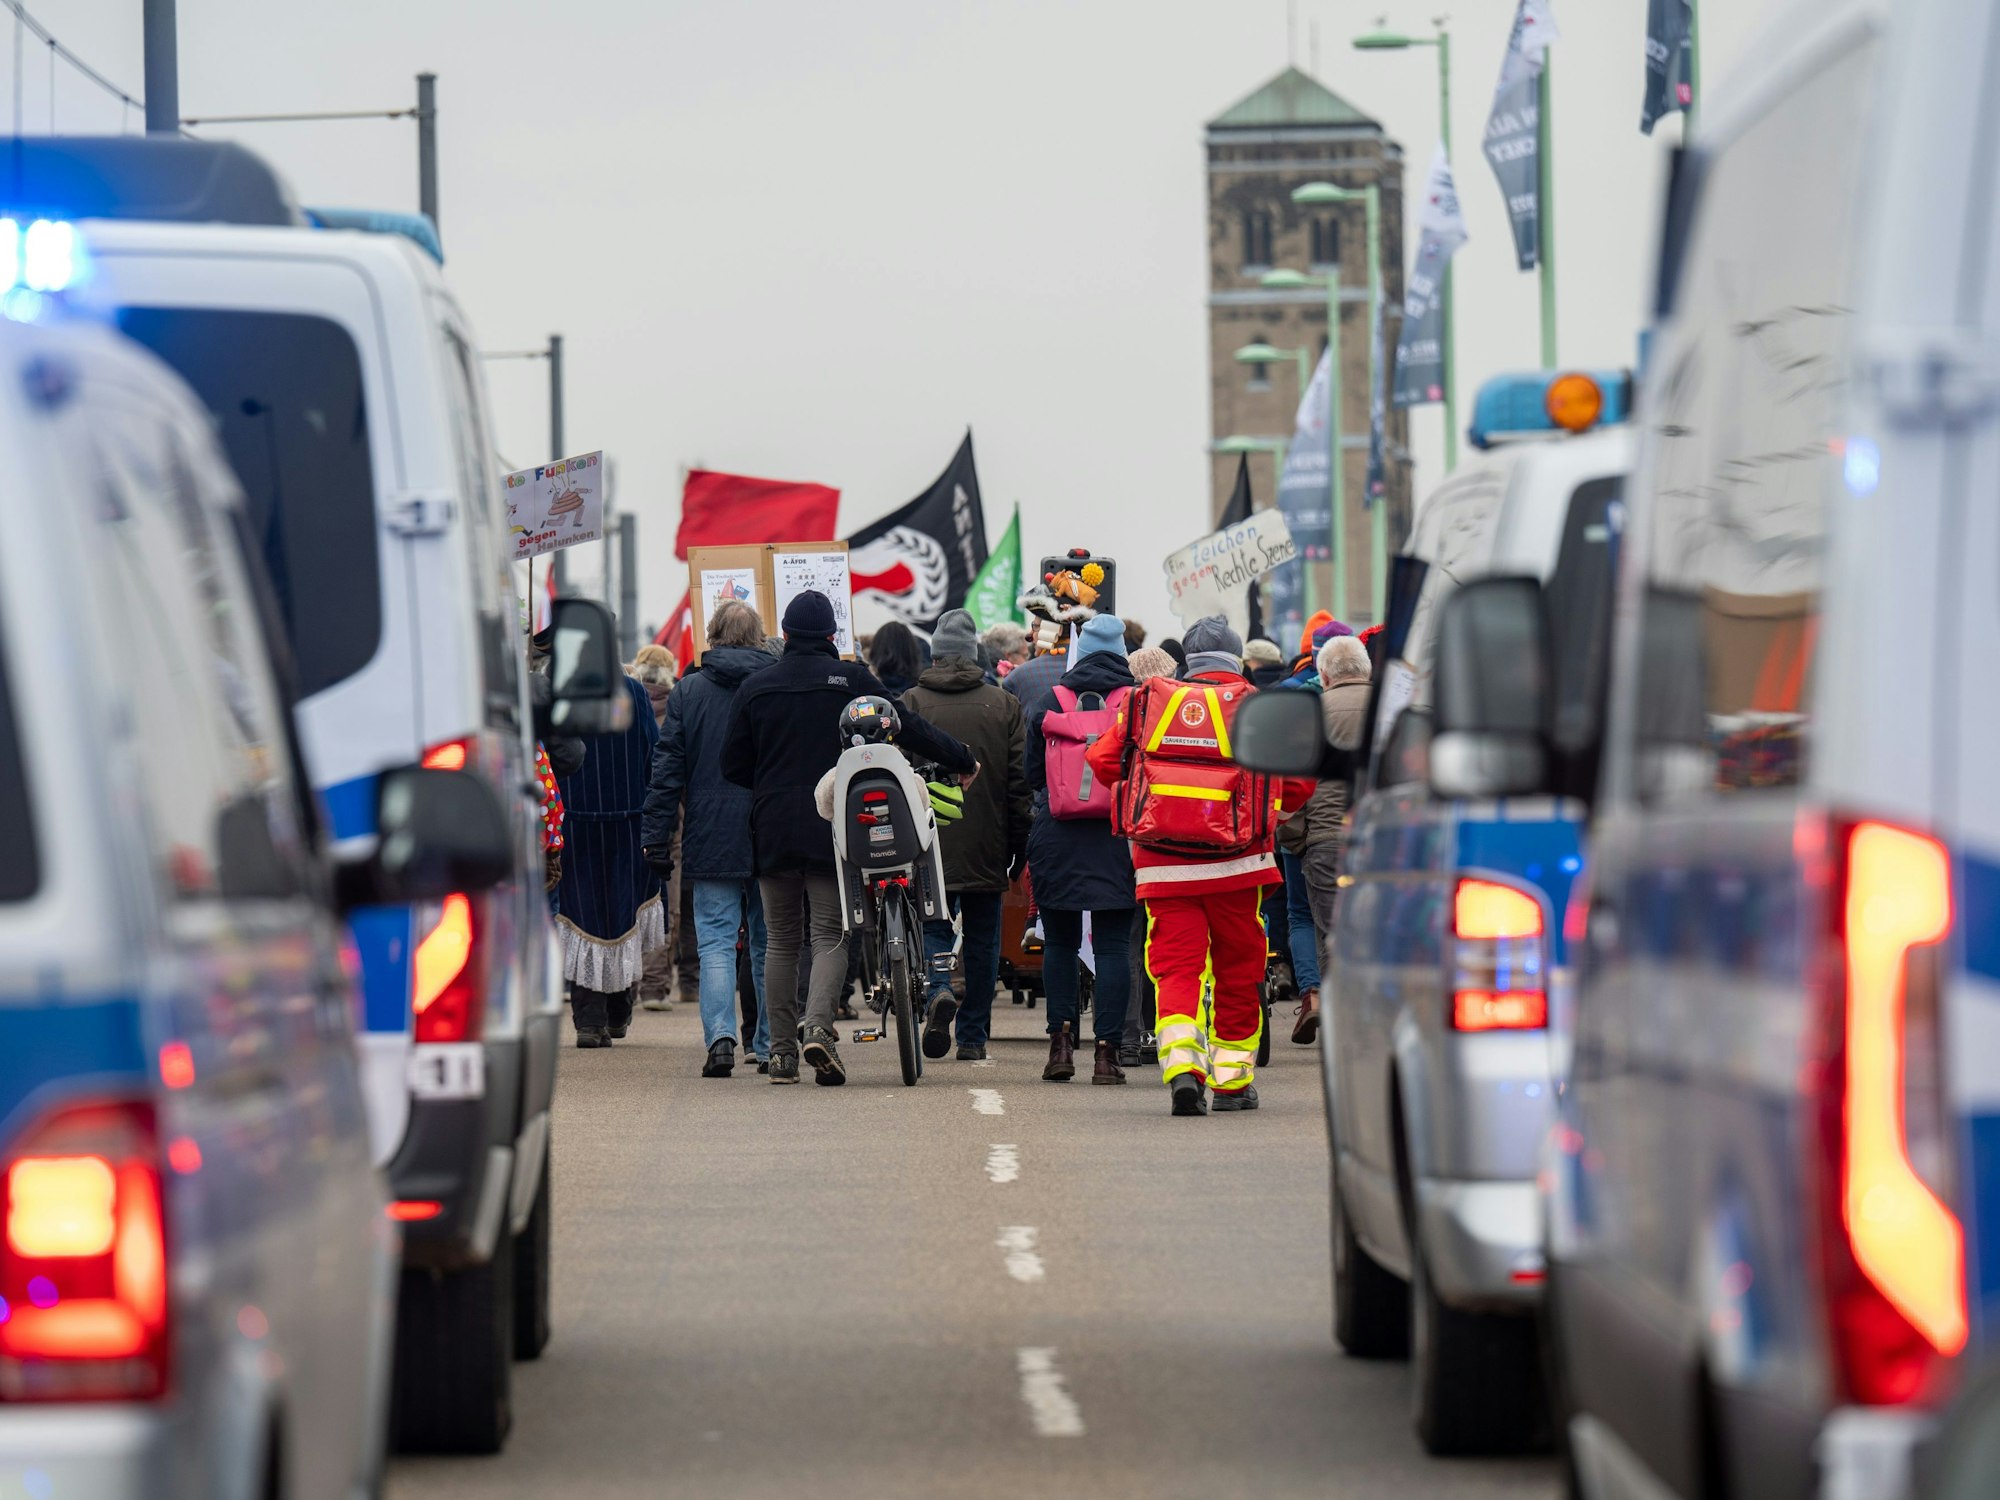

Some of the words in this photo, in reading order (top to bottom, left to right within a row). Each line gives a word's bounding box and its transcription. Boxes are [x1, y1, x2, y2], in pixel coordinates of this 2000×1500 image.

[534, 455, 598, 482] Funken
[518, 530, 557, 548] gegen
[537, 531, 594, 552] Halunken
[1190, 526, 1257, 568] Zeichen
[1173, 565, 1213, 598] gegen
[1211, 549, 1259, 592] Rechte
[1256, 535, 1293, 570] Szene
